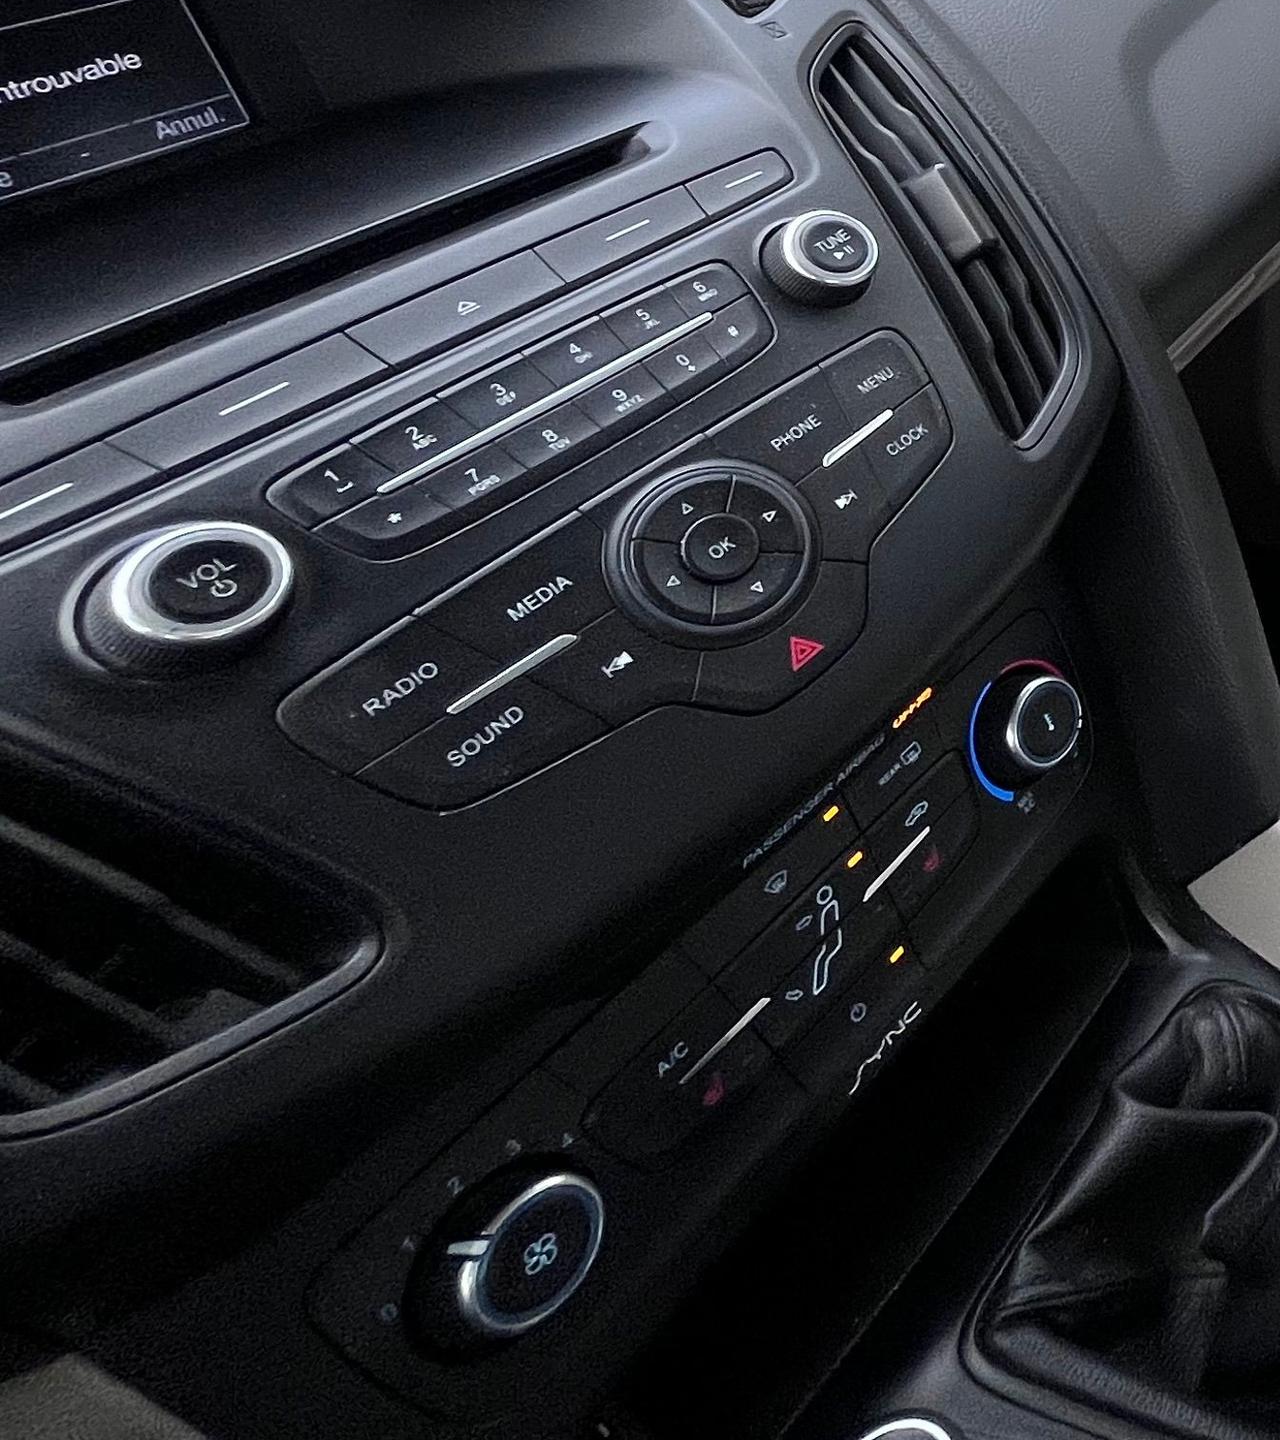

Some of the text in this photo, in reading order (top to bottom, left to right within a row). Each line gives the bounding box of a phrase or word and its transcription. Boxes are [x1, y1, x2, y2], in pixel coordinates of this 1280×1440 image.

[155, 107, 226, 141] Annul.
[814, 229, 851, 253] TUNE
[692, 281, 707, 294] 6
[635, 308, 651, 322] 5
[569, 343, 582, 354] 4
[675, 354, 690, 367] 0
[490, 383, 507, 397] 3
[856, 366, 894, 394] MENU
[611, 389, 628, 402] 9
[405, 426, 424, 442] 2
[541, 429, 557, 442] 8
[770, 413, 821, 451] PHONE
[886, 422, 929, 458] CLOCK
[324, 469, 340, 482] 1
[464, 468, 480, 482] 7
[708, 536, 736, 560] OK
[176, 557, 238, 590] VOL
[506, 575, 573, 622] MEDIA
[361, 662, 439, 717] RADIO
[446, 705, 525, 768] SOUND
[743, 733, 885, 869] PASSENGER AIRBAG
[658, 1041, 689, 1079] A/C
[448, 1175, 465, 1198] 2
